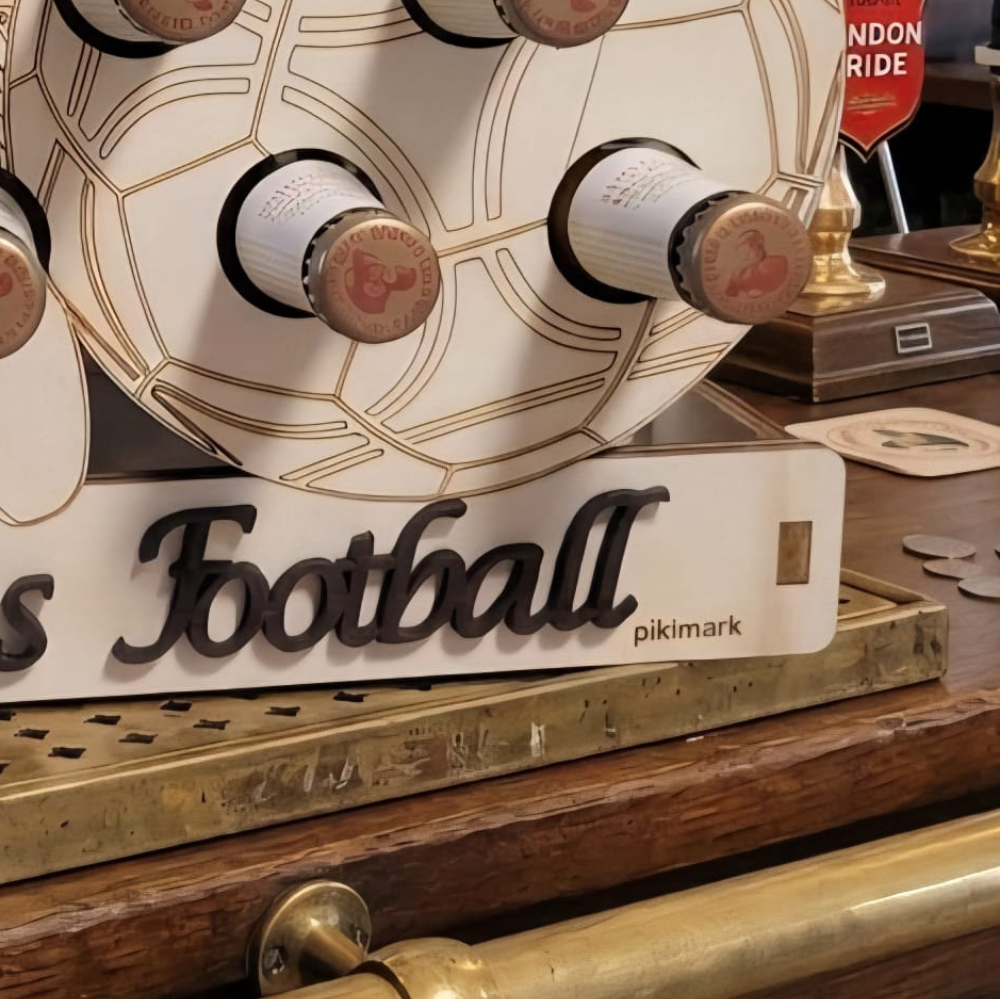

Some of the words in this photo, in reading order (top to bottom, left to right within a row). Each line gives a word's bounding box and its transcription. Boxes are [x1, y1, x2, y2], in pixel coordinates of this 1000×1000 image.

[848, 20, 923, 47] NDON
[846, 52, 908, 78] RIDE
[111, 485, 671, 665] Football
[633, 614, 742, 648] pikimark
